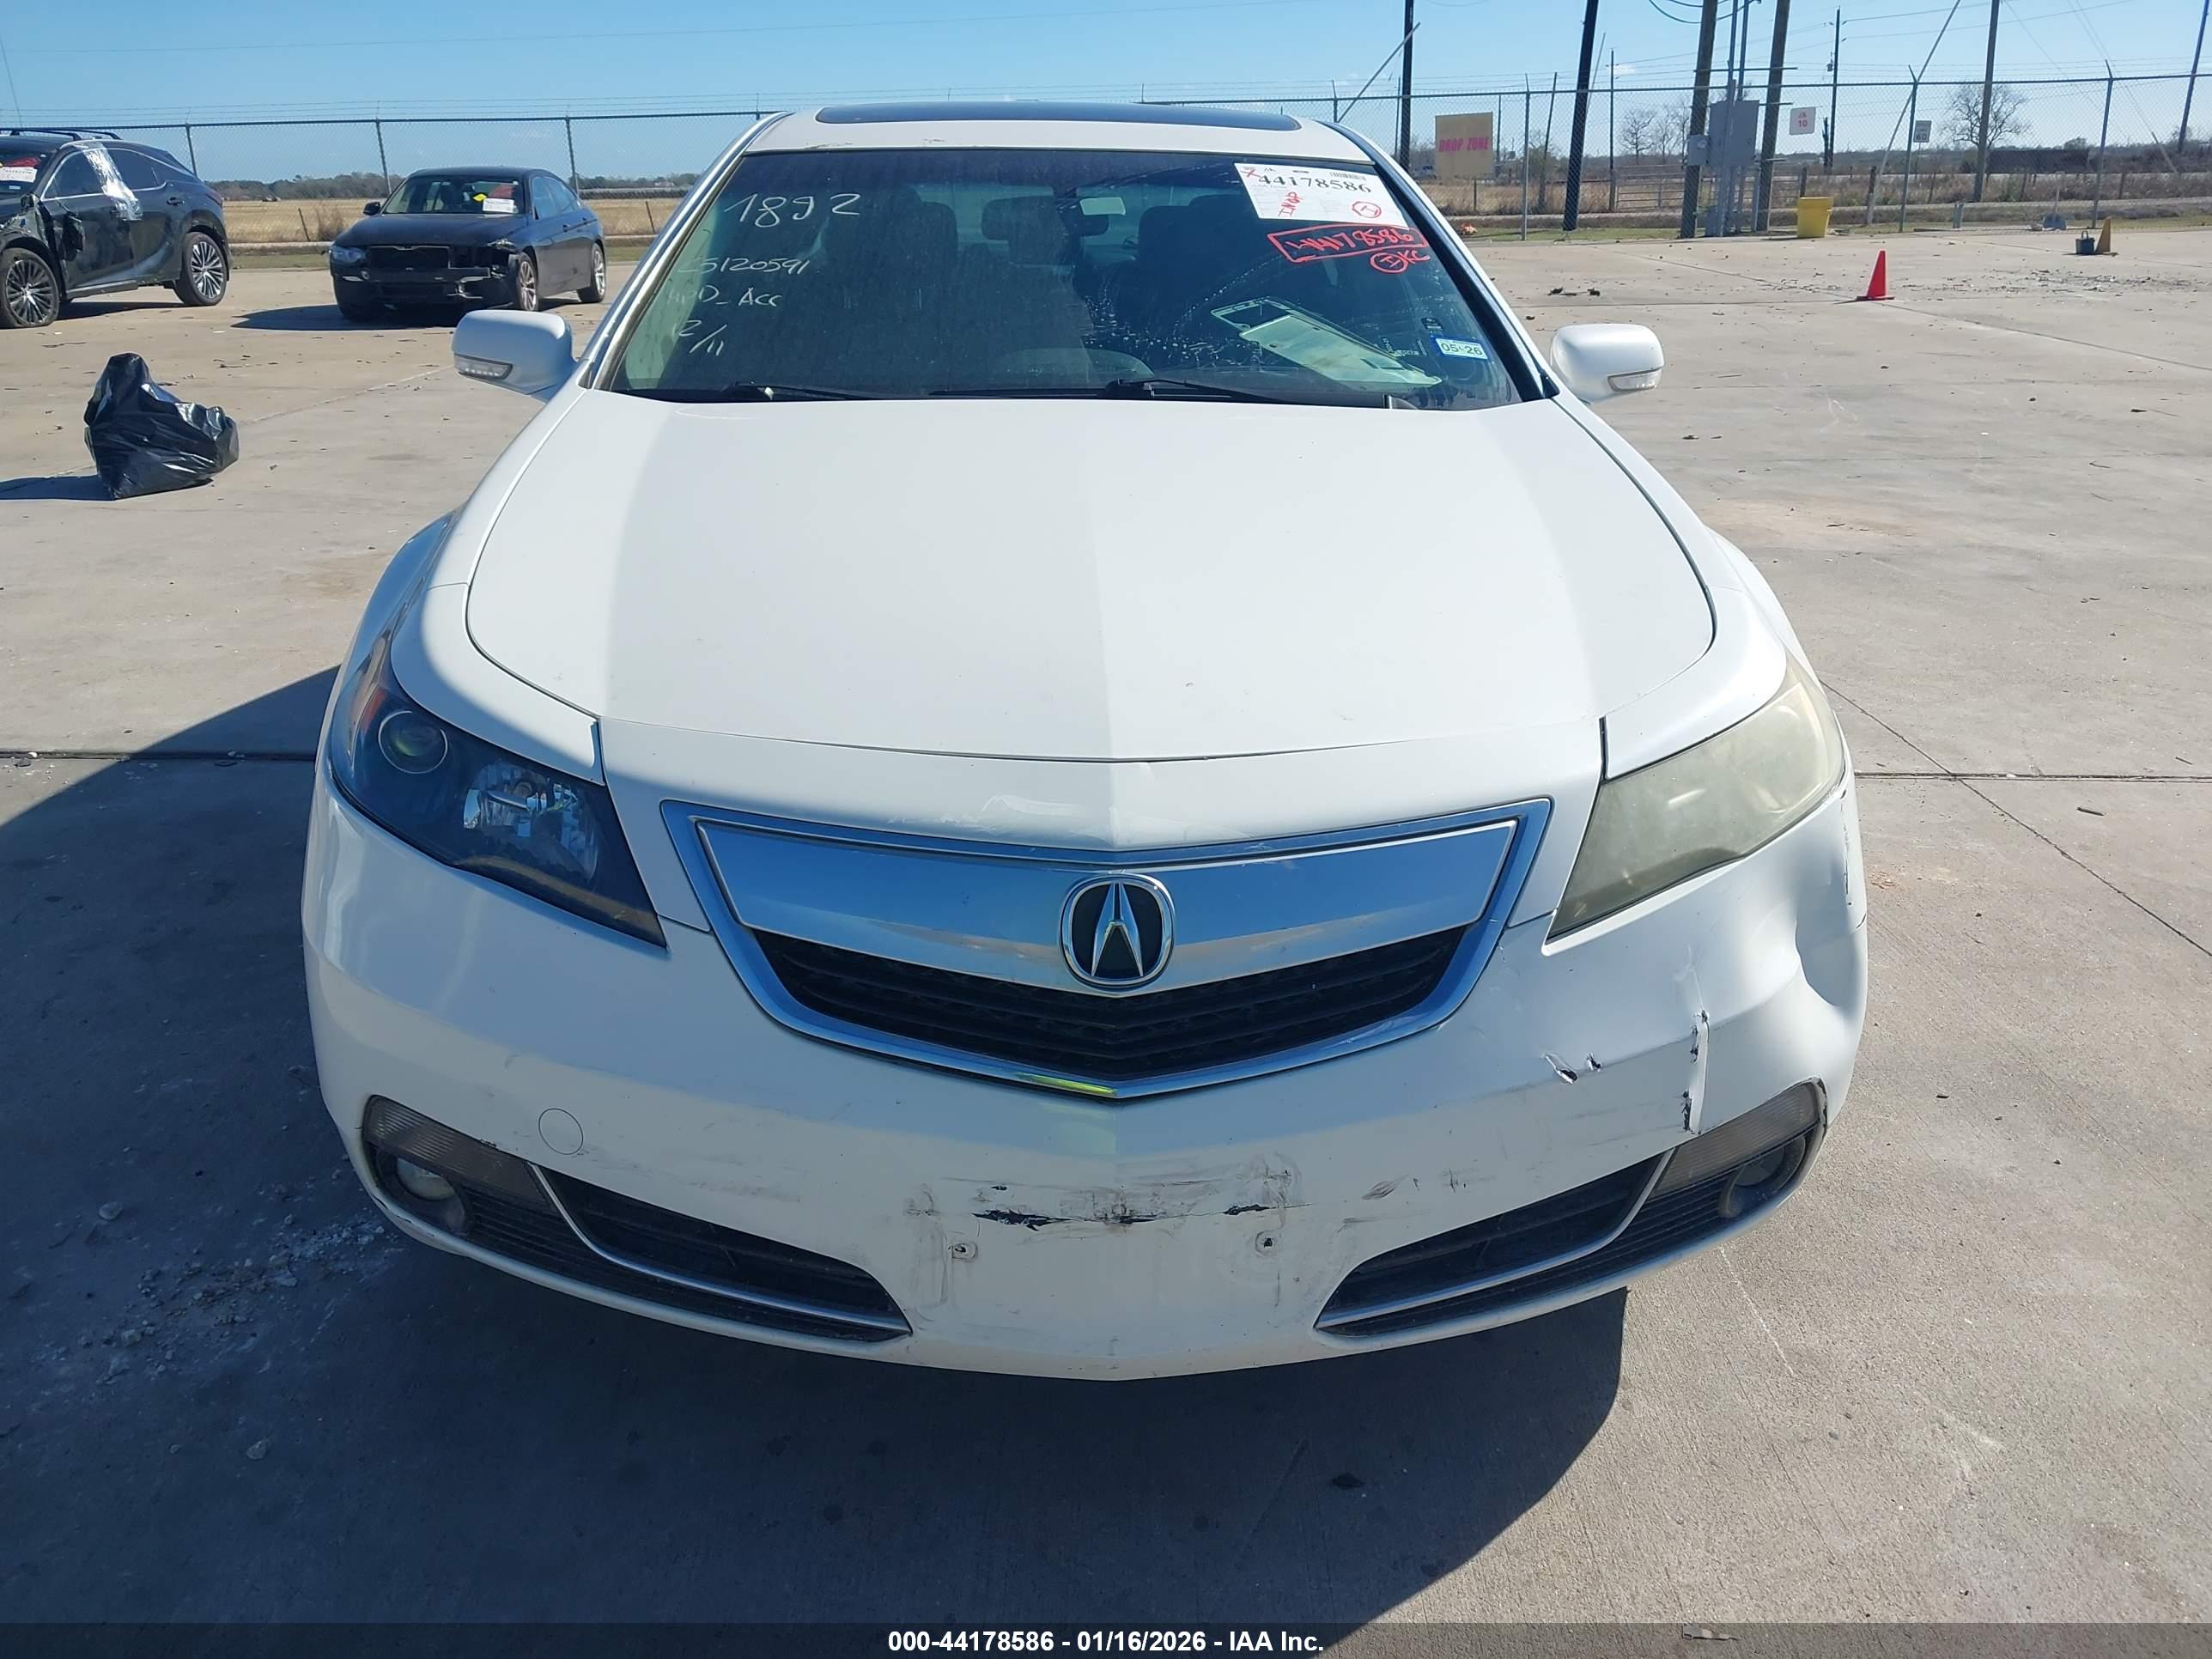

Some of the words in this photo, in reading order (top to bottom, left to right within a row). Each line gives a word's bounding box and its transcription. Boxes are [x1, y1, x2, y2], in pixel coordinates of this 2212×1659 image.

[1797, 119, 1808, 128] 10
[1437, 137, 1463, 152] DROP
[1467, 136, 1489, 151] ZONE
[1258, 174, 1372, 194] 44178586
